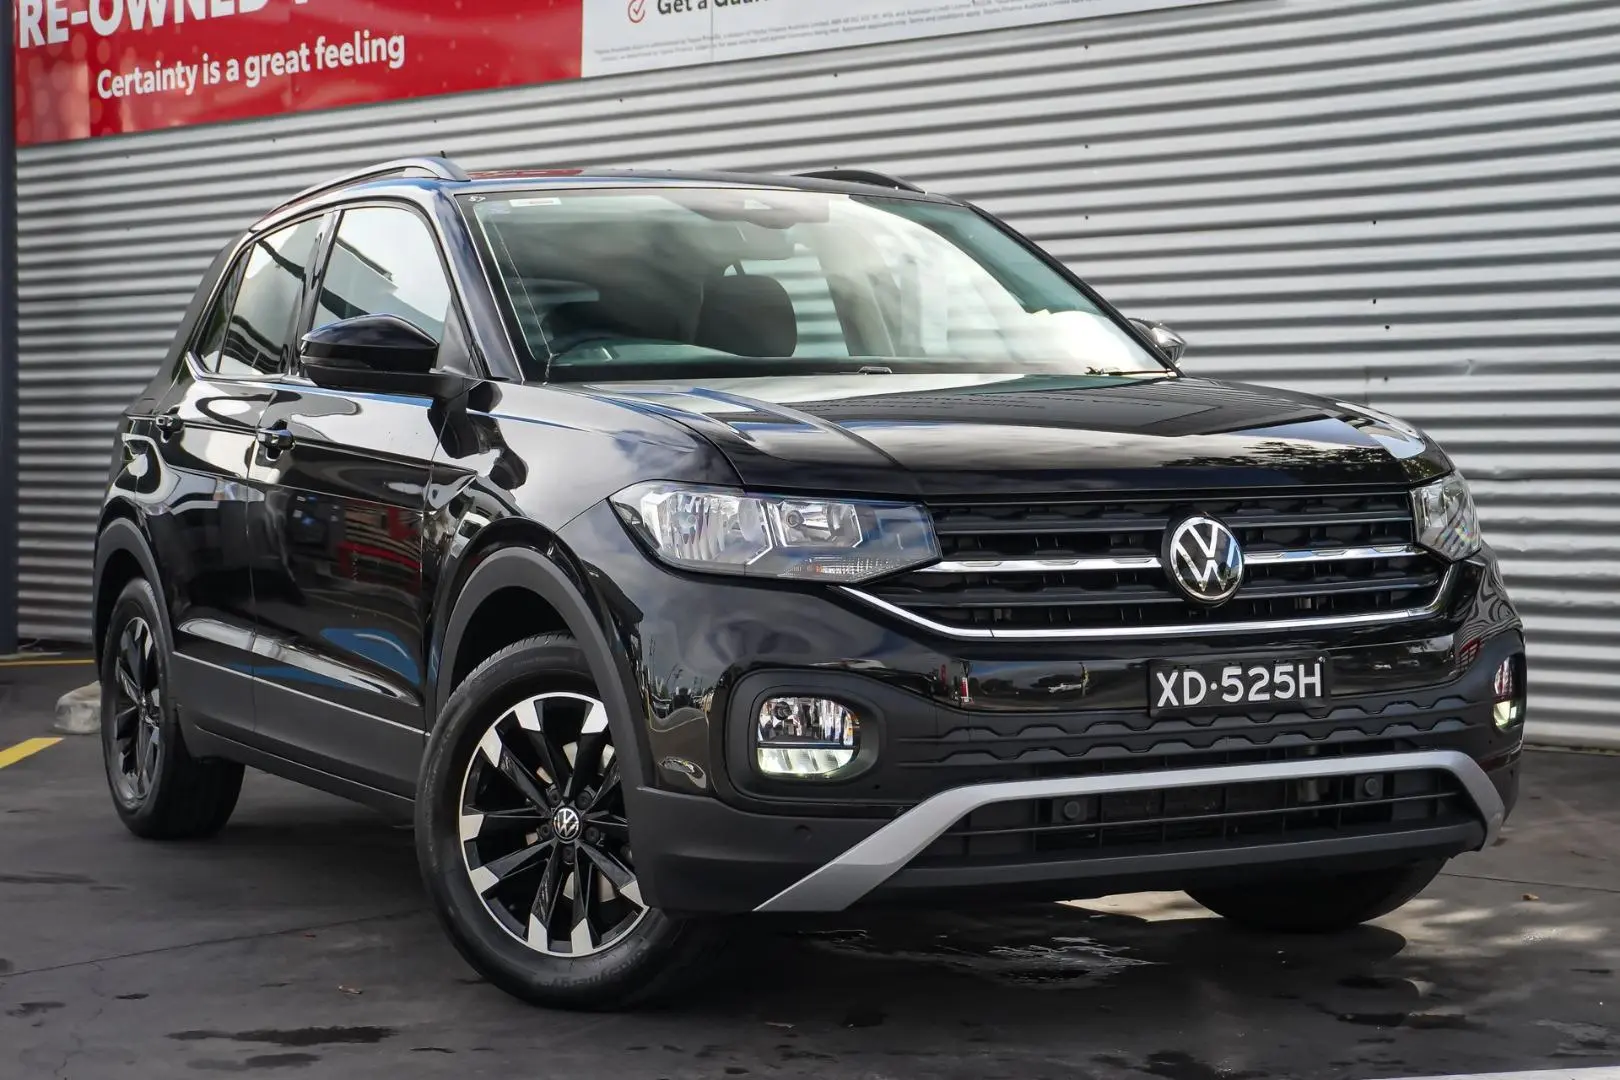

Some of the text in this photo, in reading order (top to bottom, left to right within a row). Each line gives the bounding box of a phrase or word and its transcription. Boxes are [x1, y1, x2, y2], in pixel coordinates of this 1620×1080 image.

[658, 0, 692, 15] Get
[697, 0, 707, 10] a
[97, 29, 405, 99] Certainty is a great feeling
